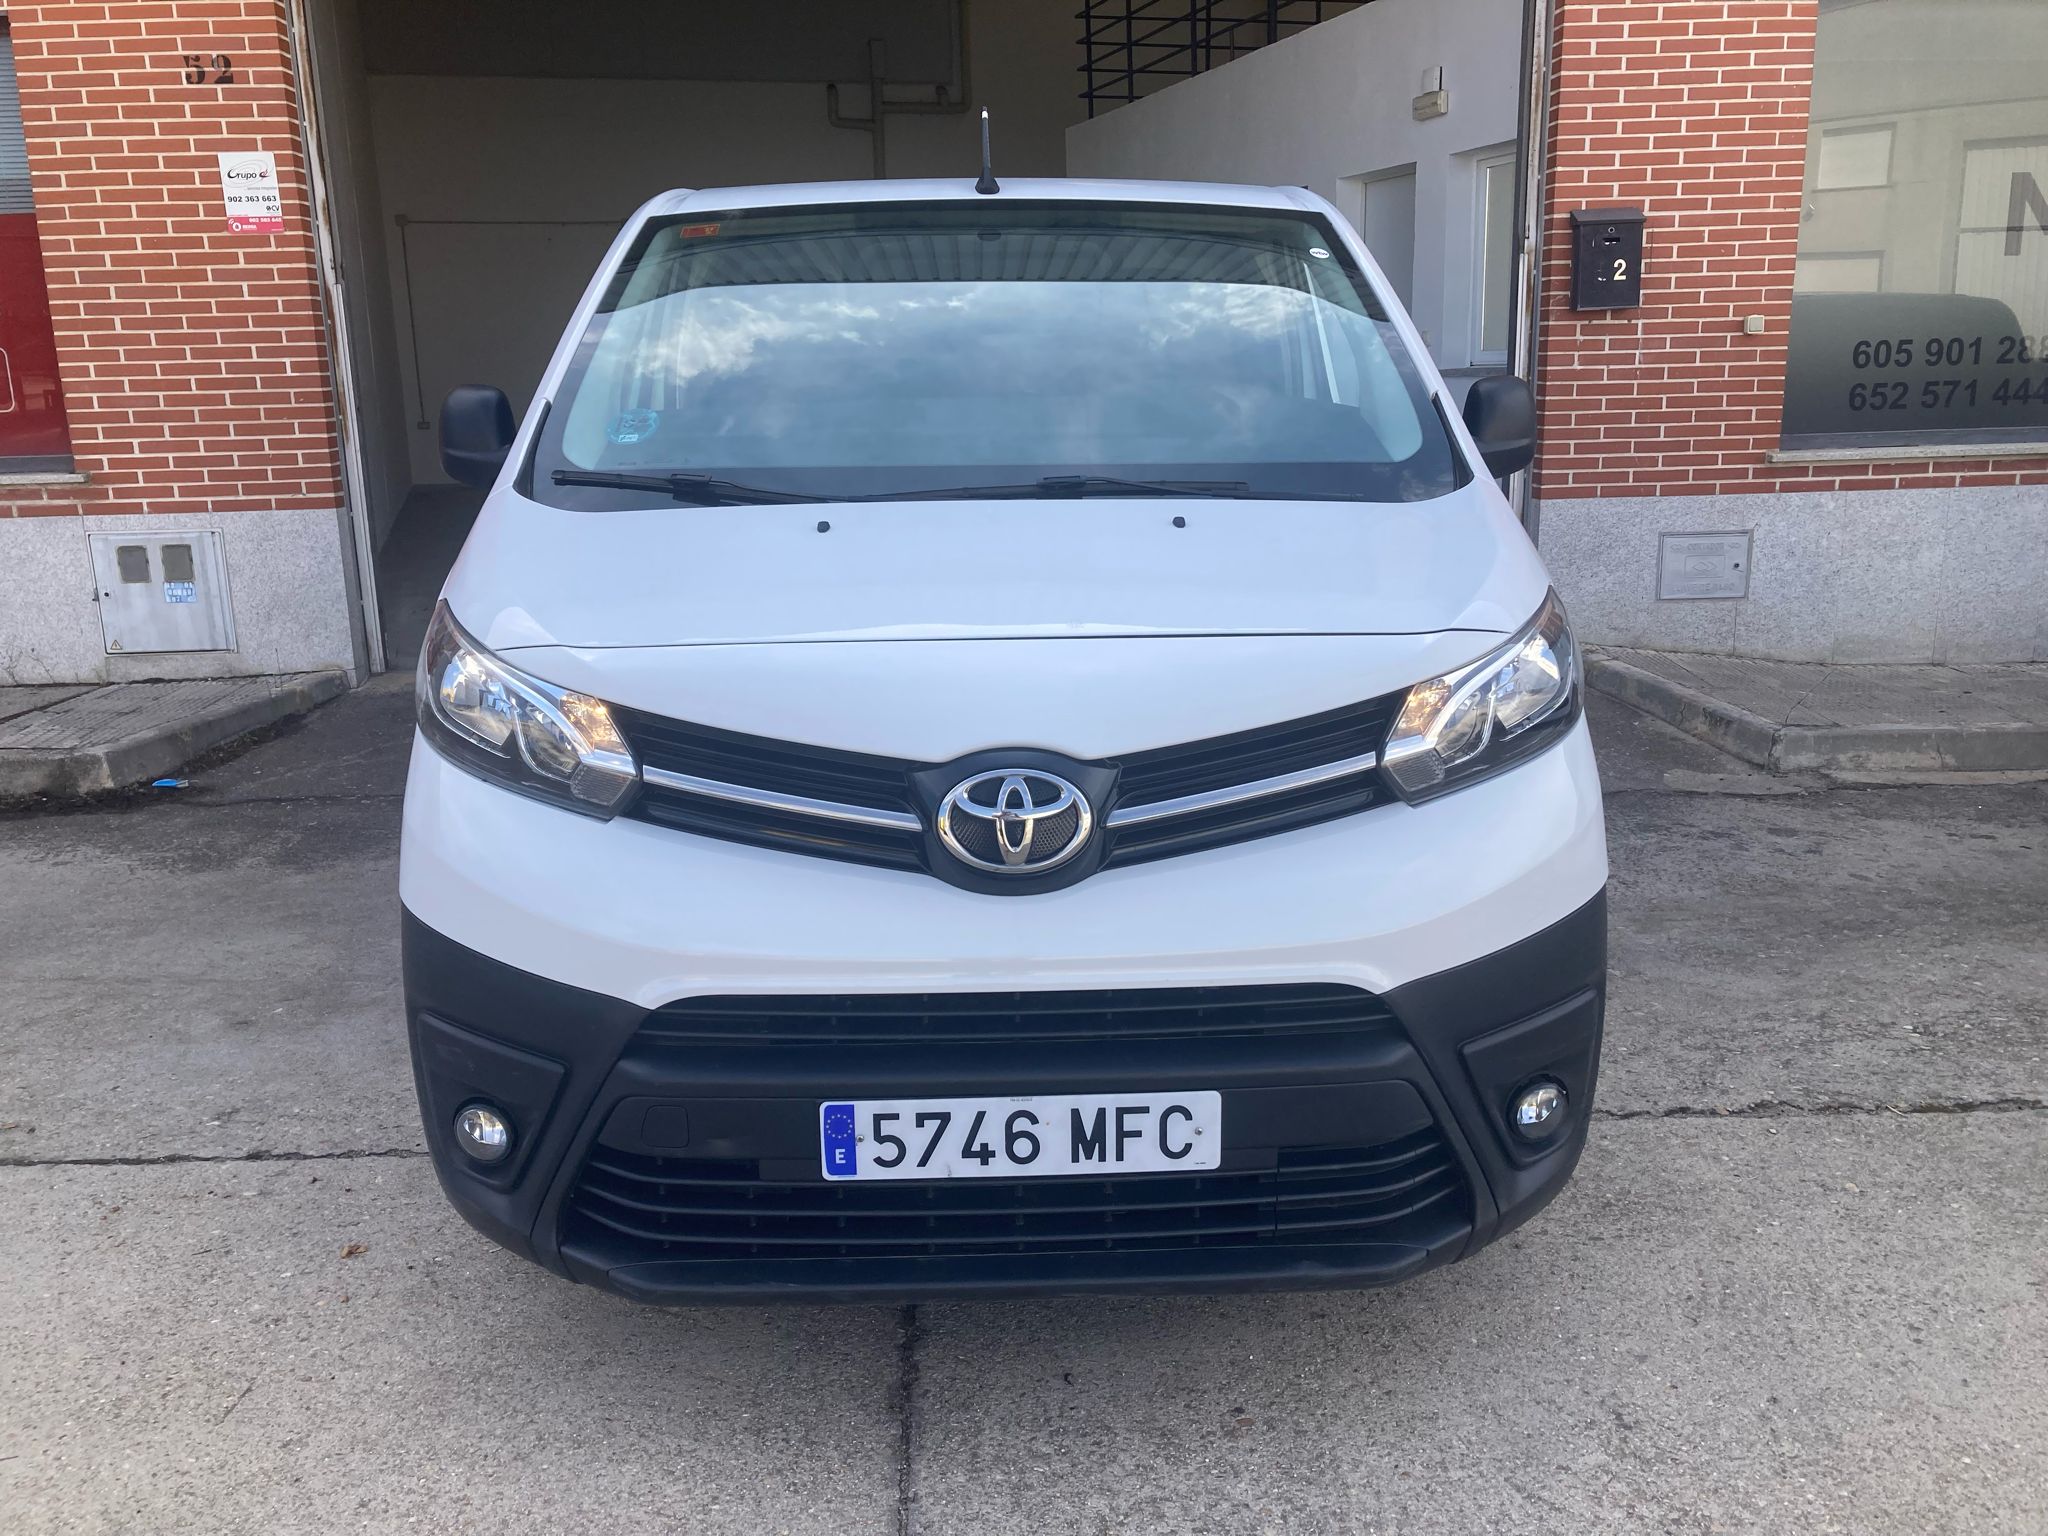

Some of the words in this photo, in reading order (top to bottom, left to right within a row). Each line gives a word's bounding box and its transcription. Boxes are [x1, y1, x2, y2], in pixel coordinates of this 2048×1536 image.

[183, 54, 234, 84] 52
[227, 169, 257, 180] Grupo
[1613, 258, 1627, 280] 2
[1852, 339, 1913, 369] 605
[1925, 336, 1982, 366] 901
[1848, 382, 1909, 411] 652
[1921, 379, 1978, 408] 571
[1992, 377, 2048, 406] 444
[872, 1109, 1041, 1168] 5746
[1070, 1104, 1193, 1164] MFC
[835, 1148, 846, 1164] E
